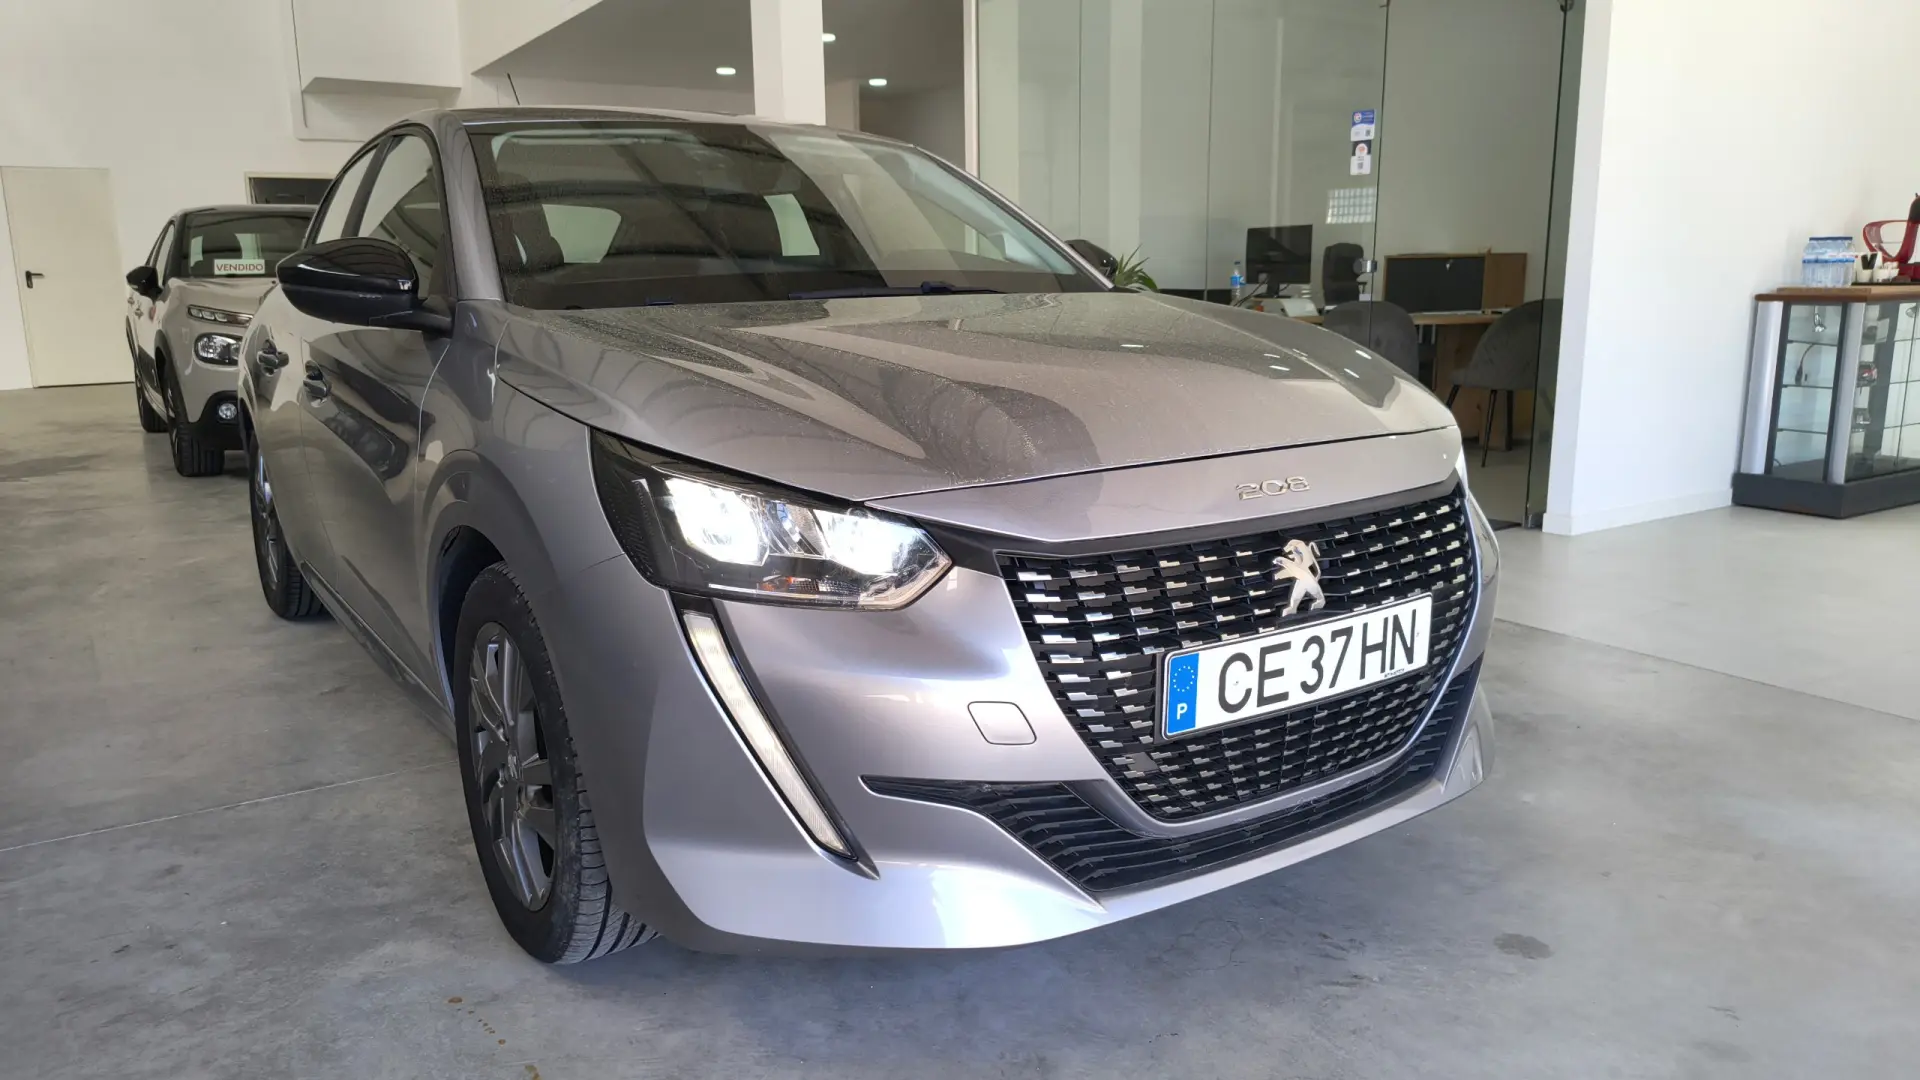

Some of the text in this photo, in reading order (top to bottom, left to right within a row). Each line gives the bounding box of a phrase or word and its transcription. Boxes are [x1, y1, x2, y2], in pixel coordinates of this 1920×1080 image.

[216, 263, 264, 271] VENDIDO
[1236, 476, 1311, 500] 208
[1217, 608, 1417, 714] CE 37 HN
[1176, 702, 1188, 720] P
